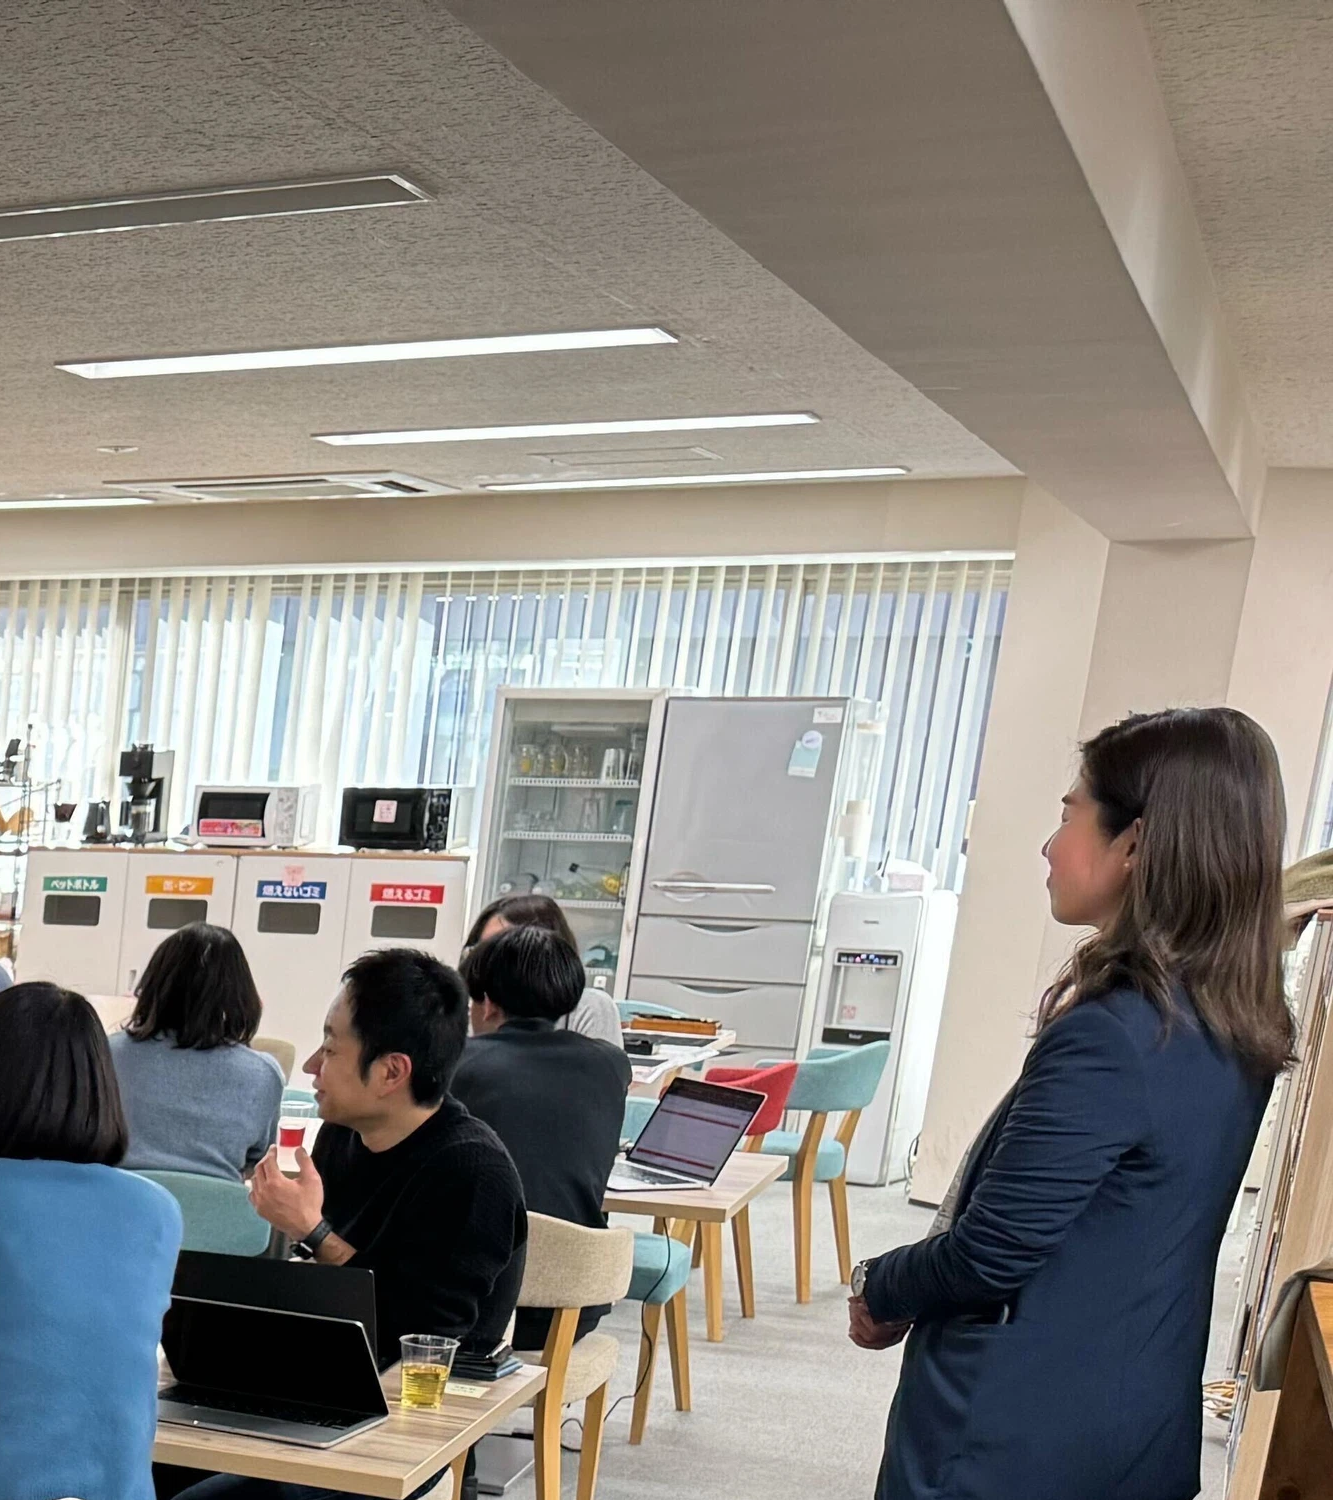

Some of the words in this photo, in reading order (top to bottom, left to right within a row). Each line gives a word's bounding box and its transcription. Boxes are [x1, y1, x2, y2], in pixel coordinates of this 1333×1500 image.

[50, 879, 100, 891] ペットボトル
[262, 885, 320, 897] 燃えないゴミ
[382, 889, 431, 901] 燃えるゴミ
